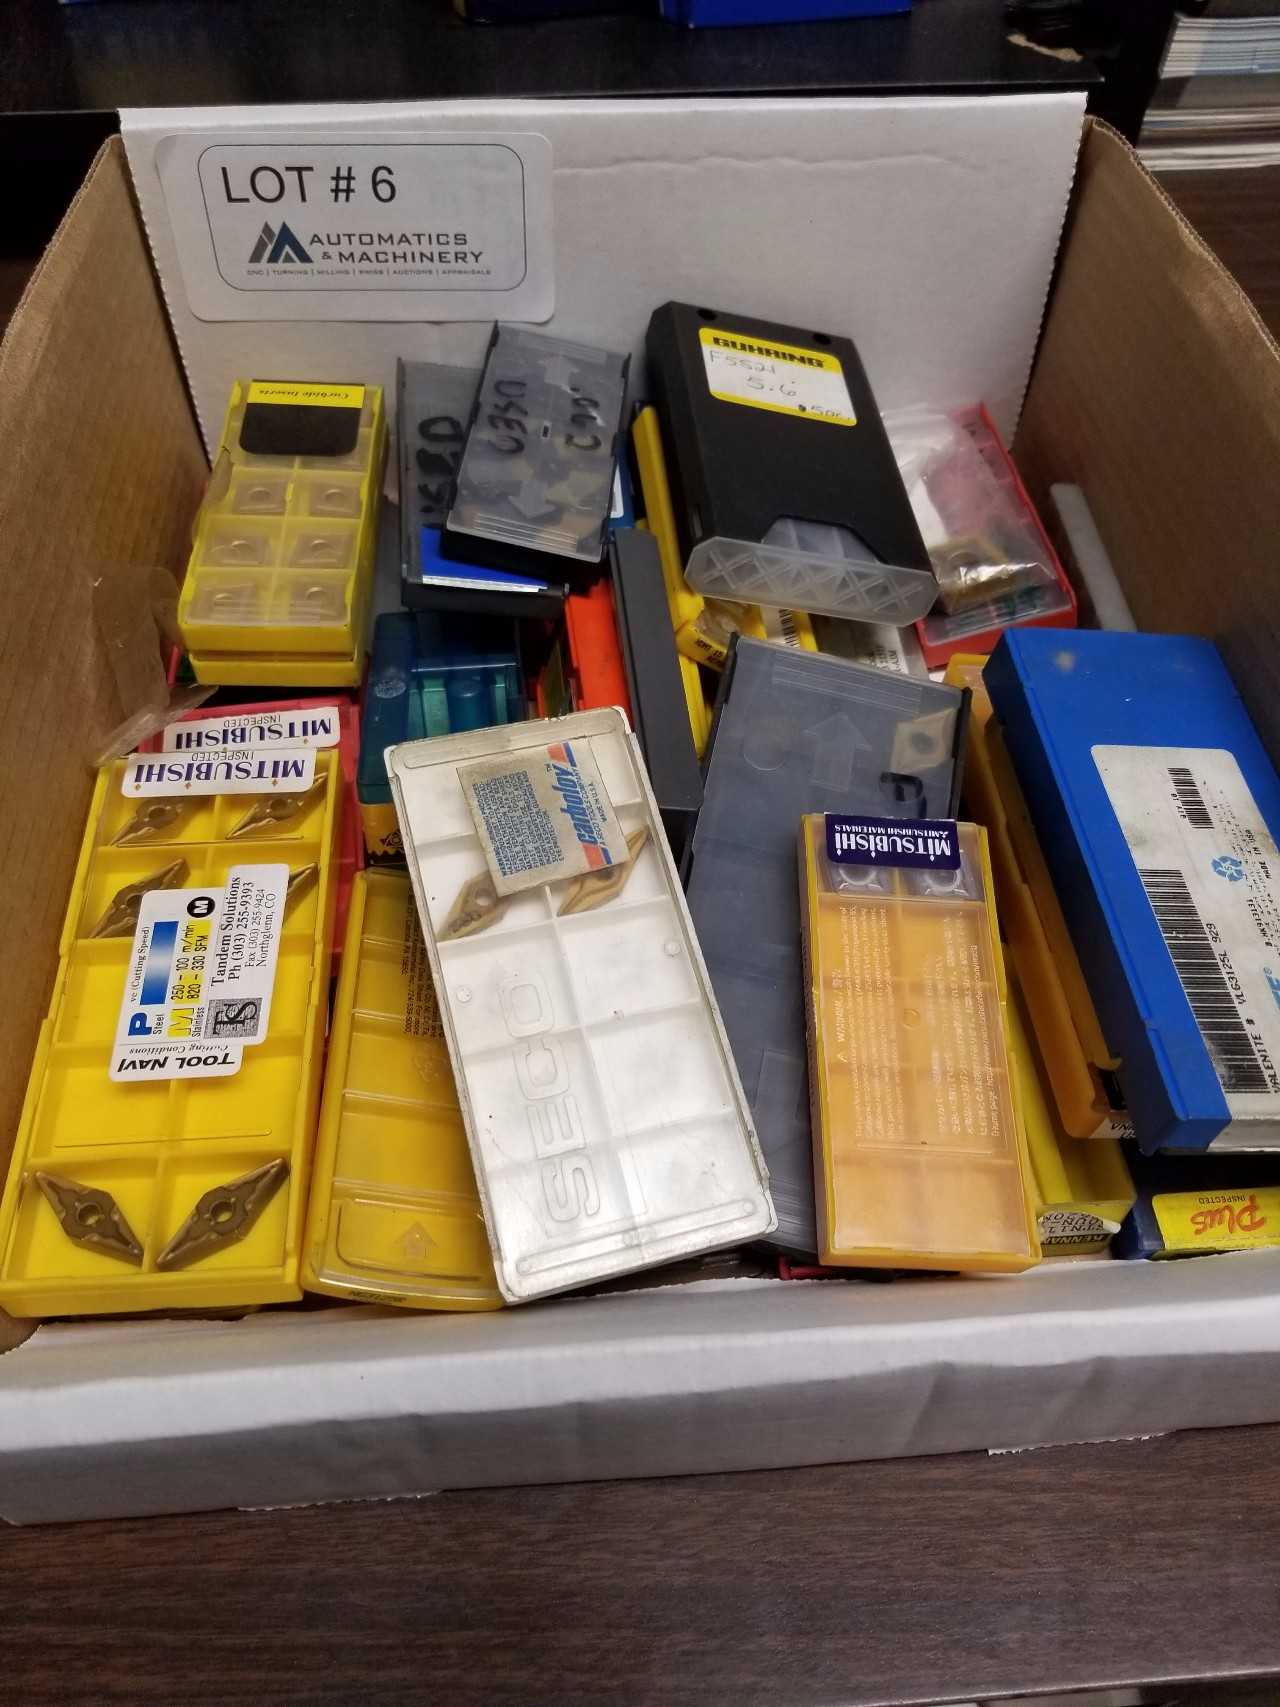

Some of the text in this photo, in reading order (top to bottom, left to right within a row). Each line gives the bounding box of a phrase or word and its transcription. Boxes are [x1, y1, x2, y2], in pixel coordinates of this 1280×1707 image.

[221, 166, 396, 203] LOT # 6
[309, 233, 467, 246] AUTOMATICS
[321, 250, 483, 263] & MACHINERY
[712, 336, 824, 368] GUHRING
[223, 715, 281, 727] INSPECTED
[175, 718, 332, 752] MITSUBISHI
[192, 752, 254, 762] INSPECTED
[134, 759, 306, 788] MITSUBISHI
[552, 763, 598, 844] carboloy
[835, 833, 951, 860] MITSUBISHI
[193, 900, 209, 913] M
[211, 876, 240, 985] Tandem Solutions
[227, 881, 254, 979] Ph (303) 255-9393
[247, 928, 259, 948] (303)
[255, 893, 276, 967] Northglenn, CO
[1205, 921, 1222, 943] 929
[194, 935, 208, 951] SFM
[175, 957, 189, 971] 100
[191, 955, 205, 970] 330
[244, 951, 255, 967] Fax
[170, 984, 185, 1000] 250
[186, 983, 200, 998] 820
[126, 1012, 154, 1036] P
[152, 1014, 164, 1034] Steel
[191, 1006, 204, 1037] Stainless
[129, 1045, 185, 1056] Conditions
[118, 1053, 235, 1072] TOOL NAVI
[498, 968, 601, 1223] SECO
[1198, 1194, 1246, 1204] INSPECTED
[1190, 1193, 1267, 1236] Plus
